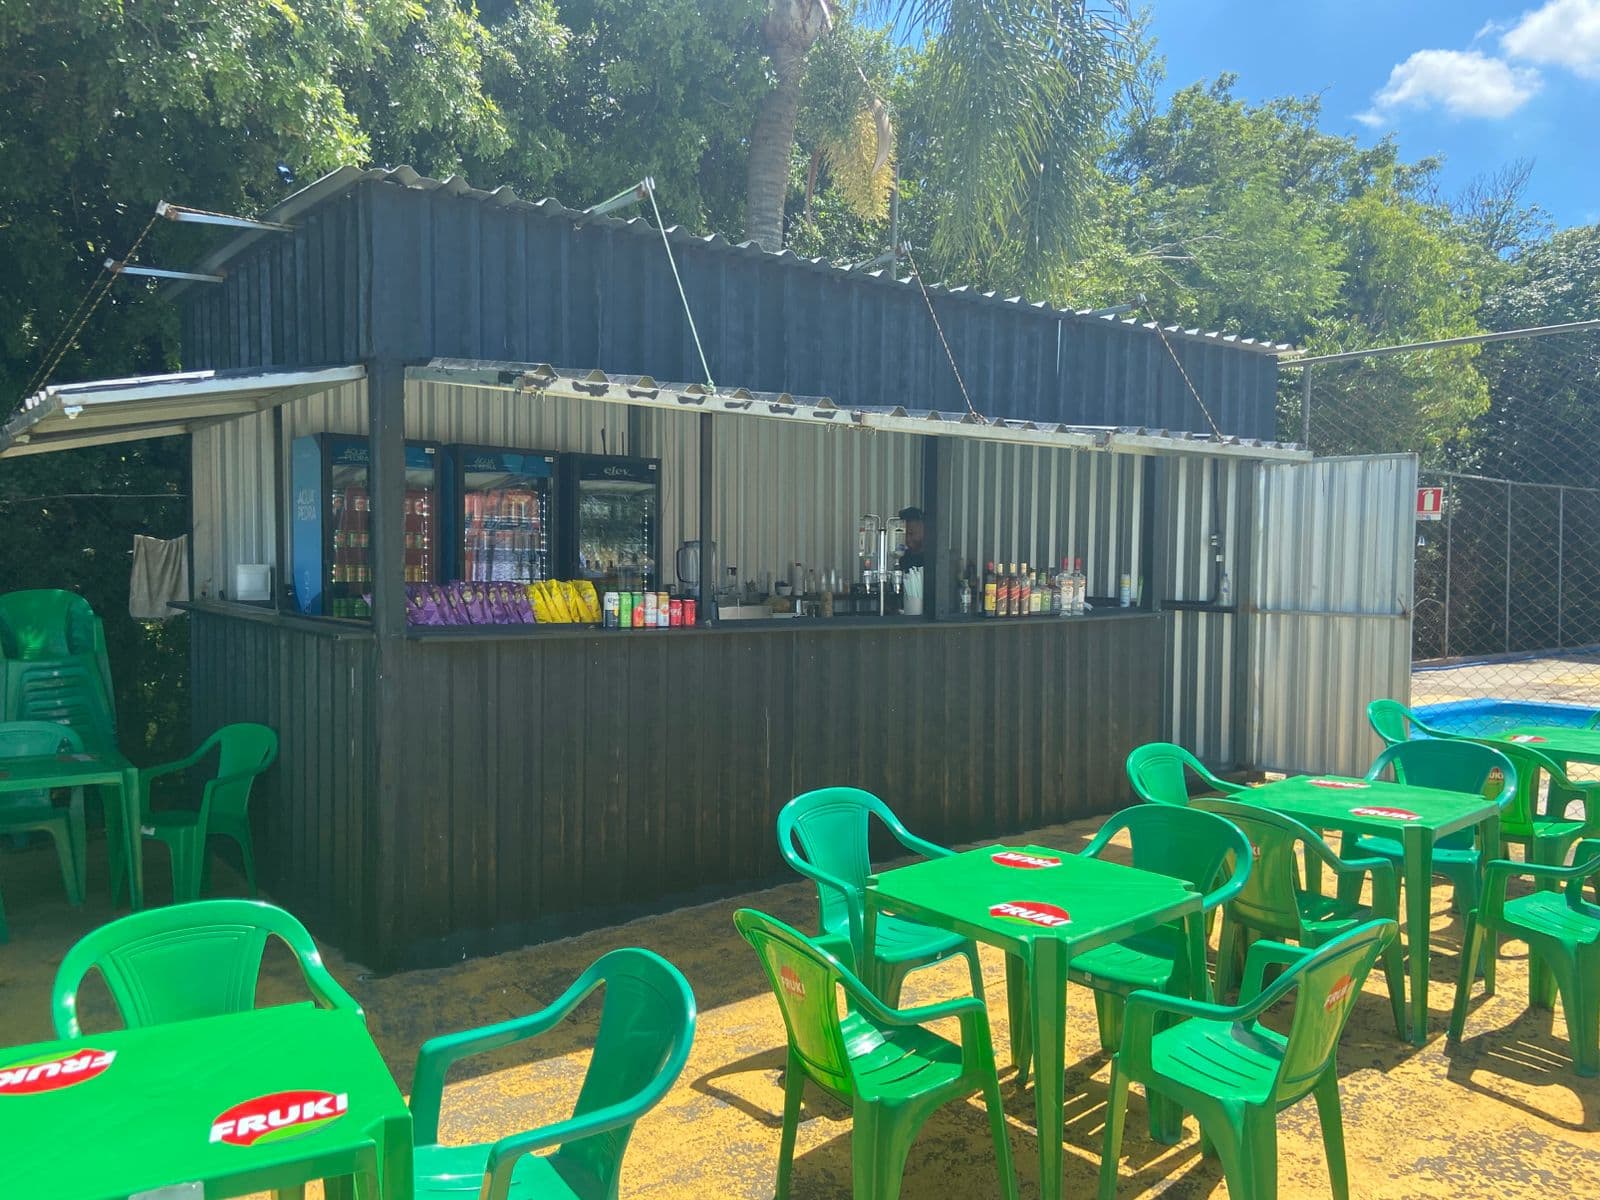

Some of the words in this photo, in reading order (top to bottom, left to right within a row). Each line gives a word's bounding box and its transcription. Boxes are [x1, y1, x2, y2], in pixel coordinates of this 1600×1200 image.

[989, 852, 1063, 868] FRUKI
[988, 903, 1073, 927] FRUKI
[0, 1051, 118, 1087] FRUK
[208, 1092, 349, 1143] FRUKI
